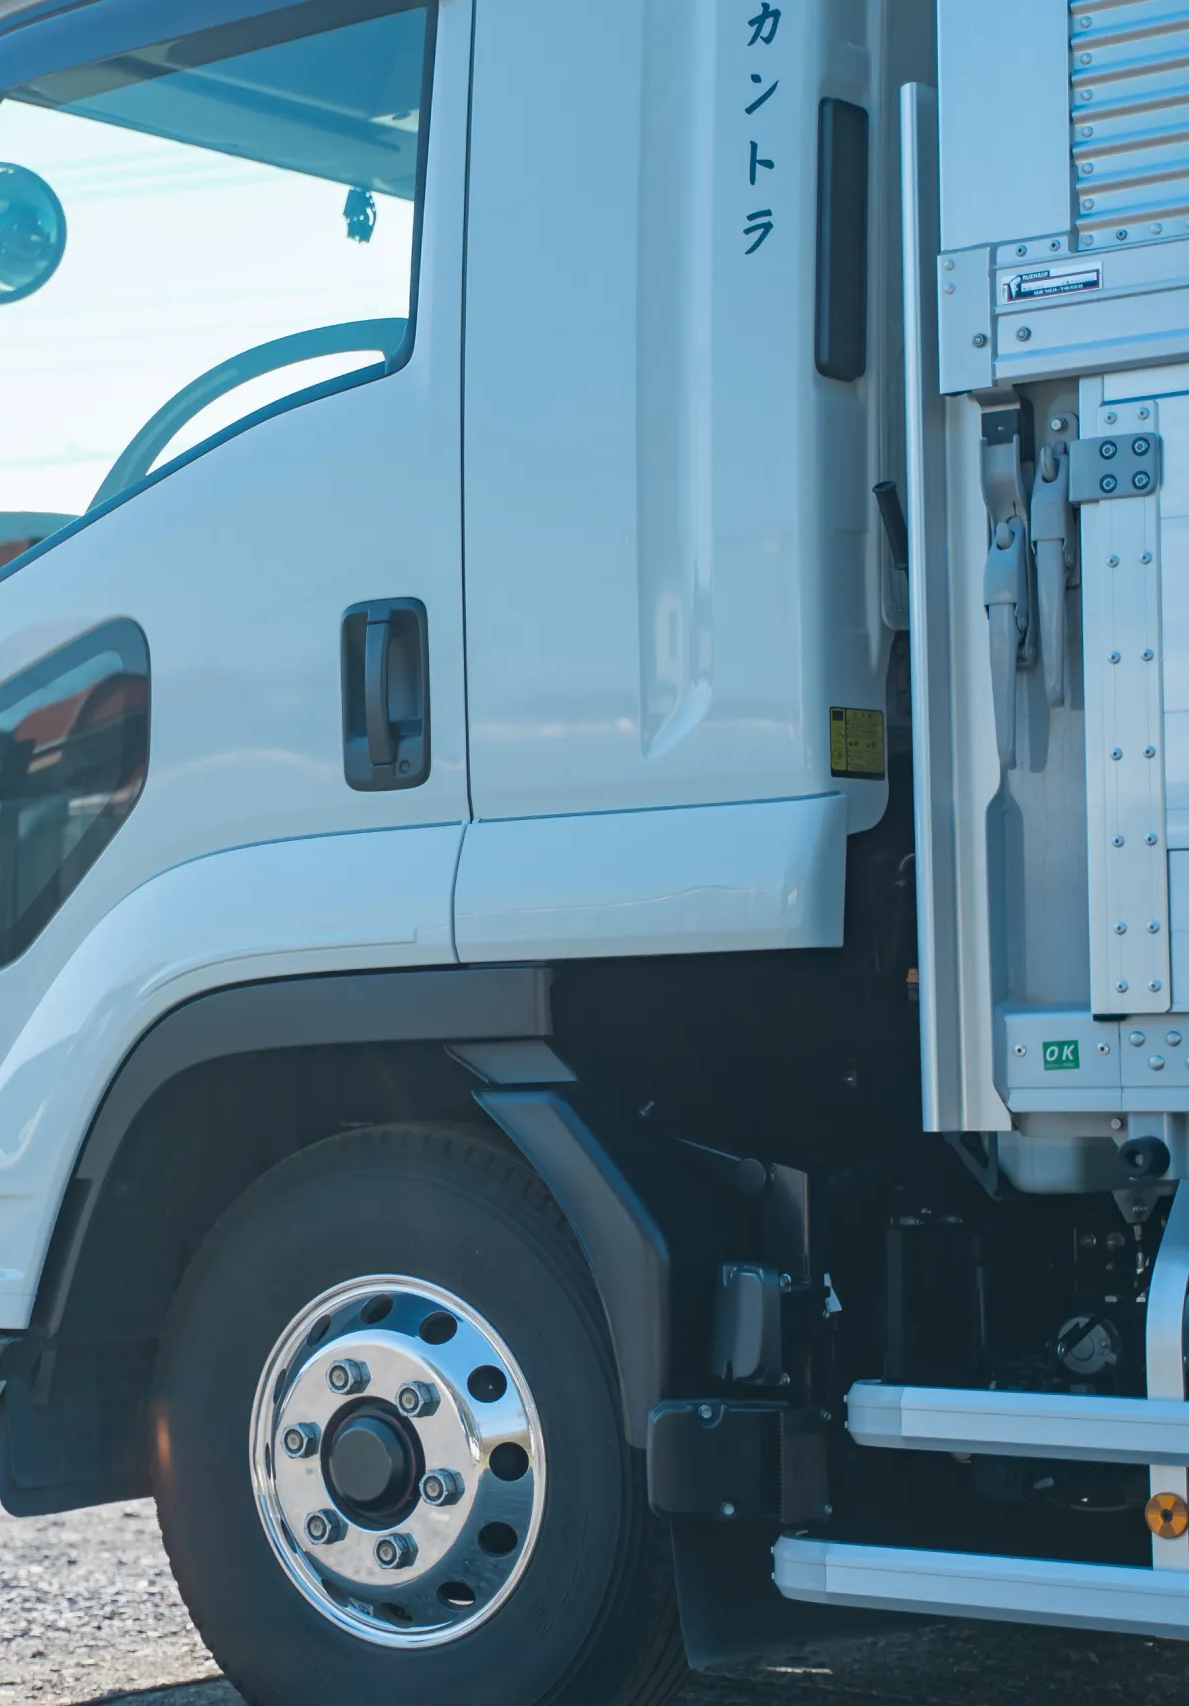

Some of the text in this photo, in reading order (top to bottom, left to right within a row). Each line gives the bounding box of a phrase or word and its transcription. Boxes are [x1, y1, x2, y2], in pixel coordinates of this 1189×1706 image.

[743, 2, 781, 256] カントラ
[1045, 1044, 1075, 1061] OK
